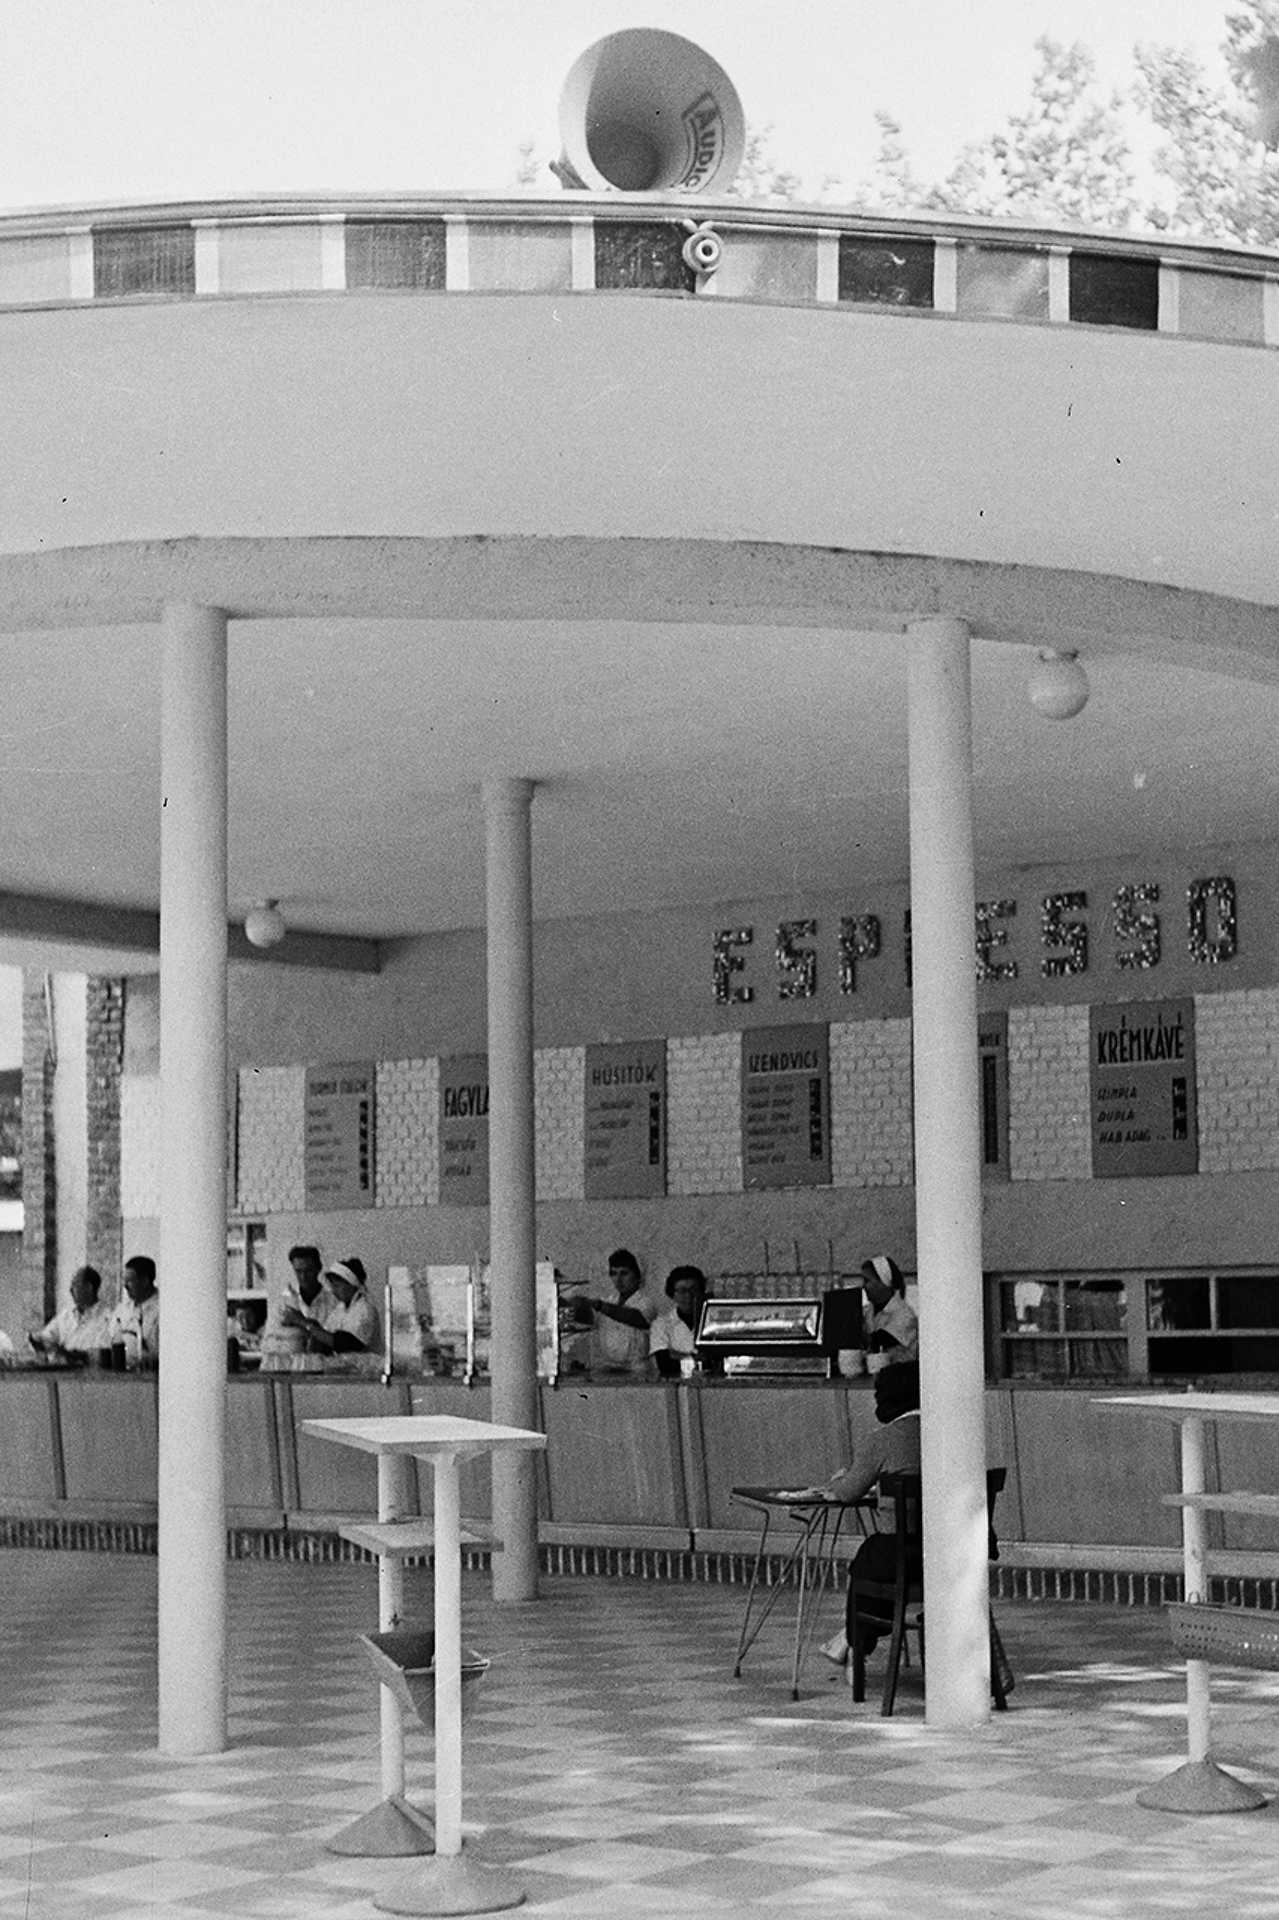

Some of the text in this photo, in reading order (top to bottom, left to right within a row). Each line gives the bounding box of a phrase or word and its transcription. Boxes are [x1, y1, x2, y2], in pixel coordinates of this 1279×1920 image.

[712, 876, 1237, 1004] ESPESSO
[1098, 1012, 1184, 1064] KRÉMKÁVÉ
[1098, 1109, 1135, 1122] DUPLA
